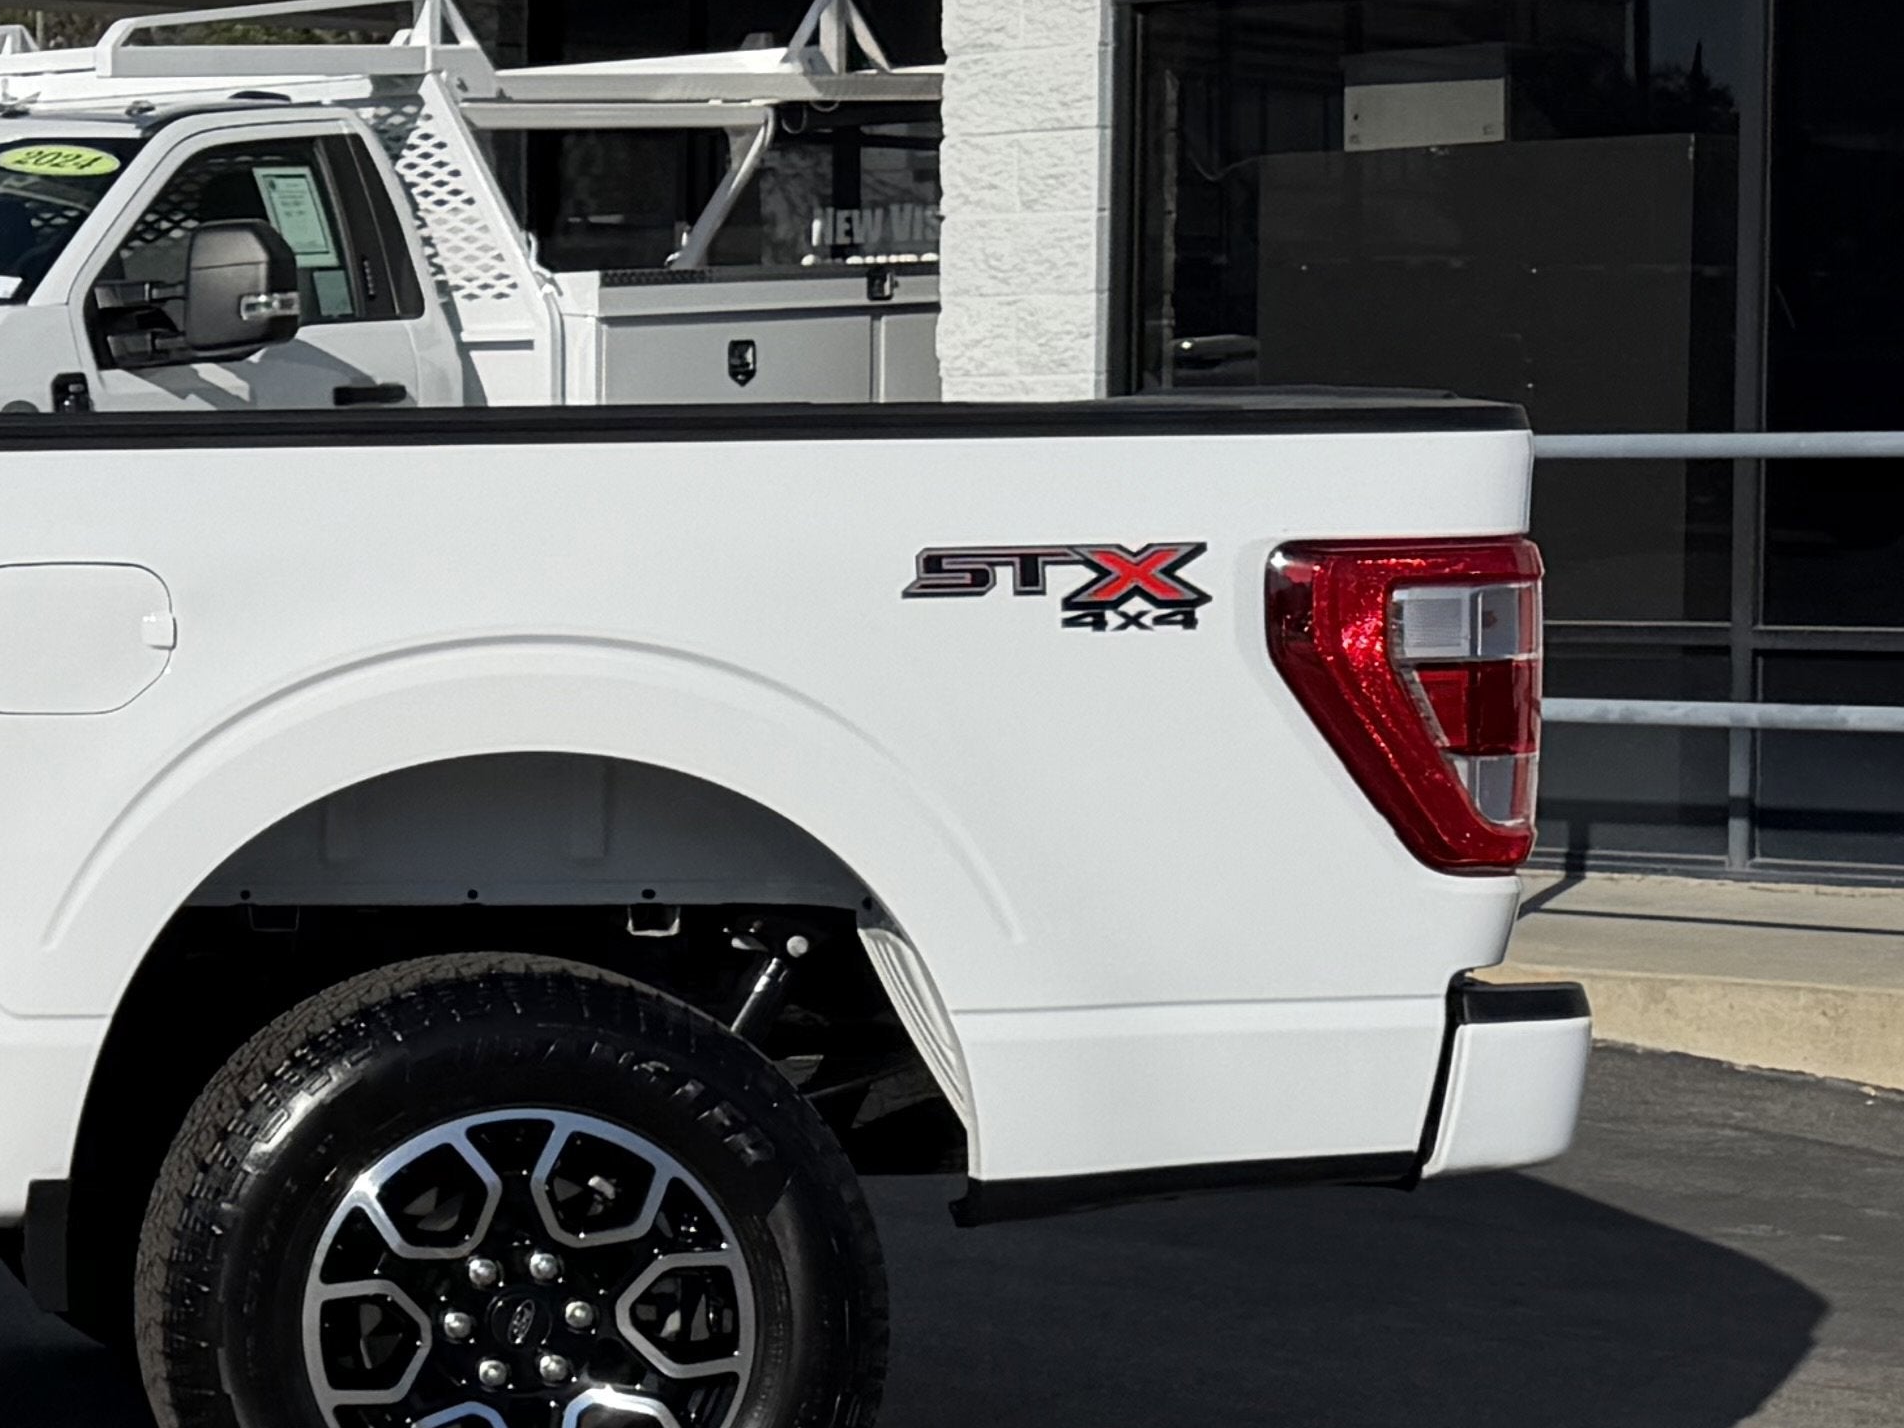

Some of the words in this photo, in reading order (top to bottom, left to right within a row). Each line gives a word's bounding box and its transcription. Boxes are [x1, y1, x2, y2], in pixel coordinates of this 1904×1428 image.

[14, 150, 104, 171] 2024
[811, 206, 884, 247] NEW
[901, 541, 1213, 612] STX
